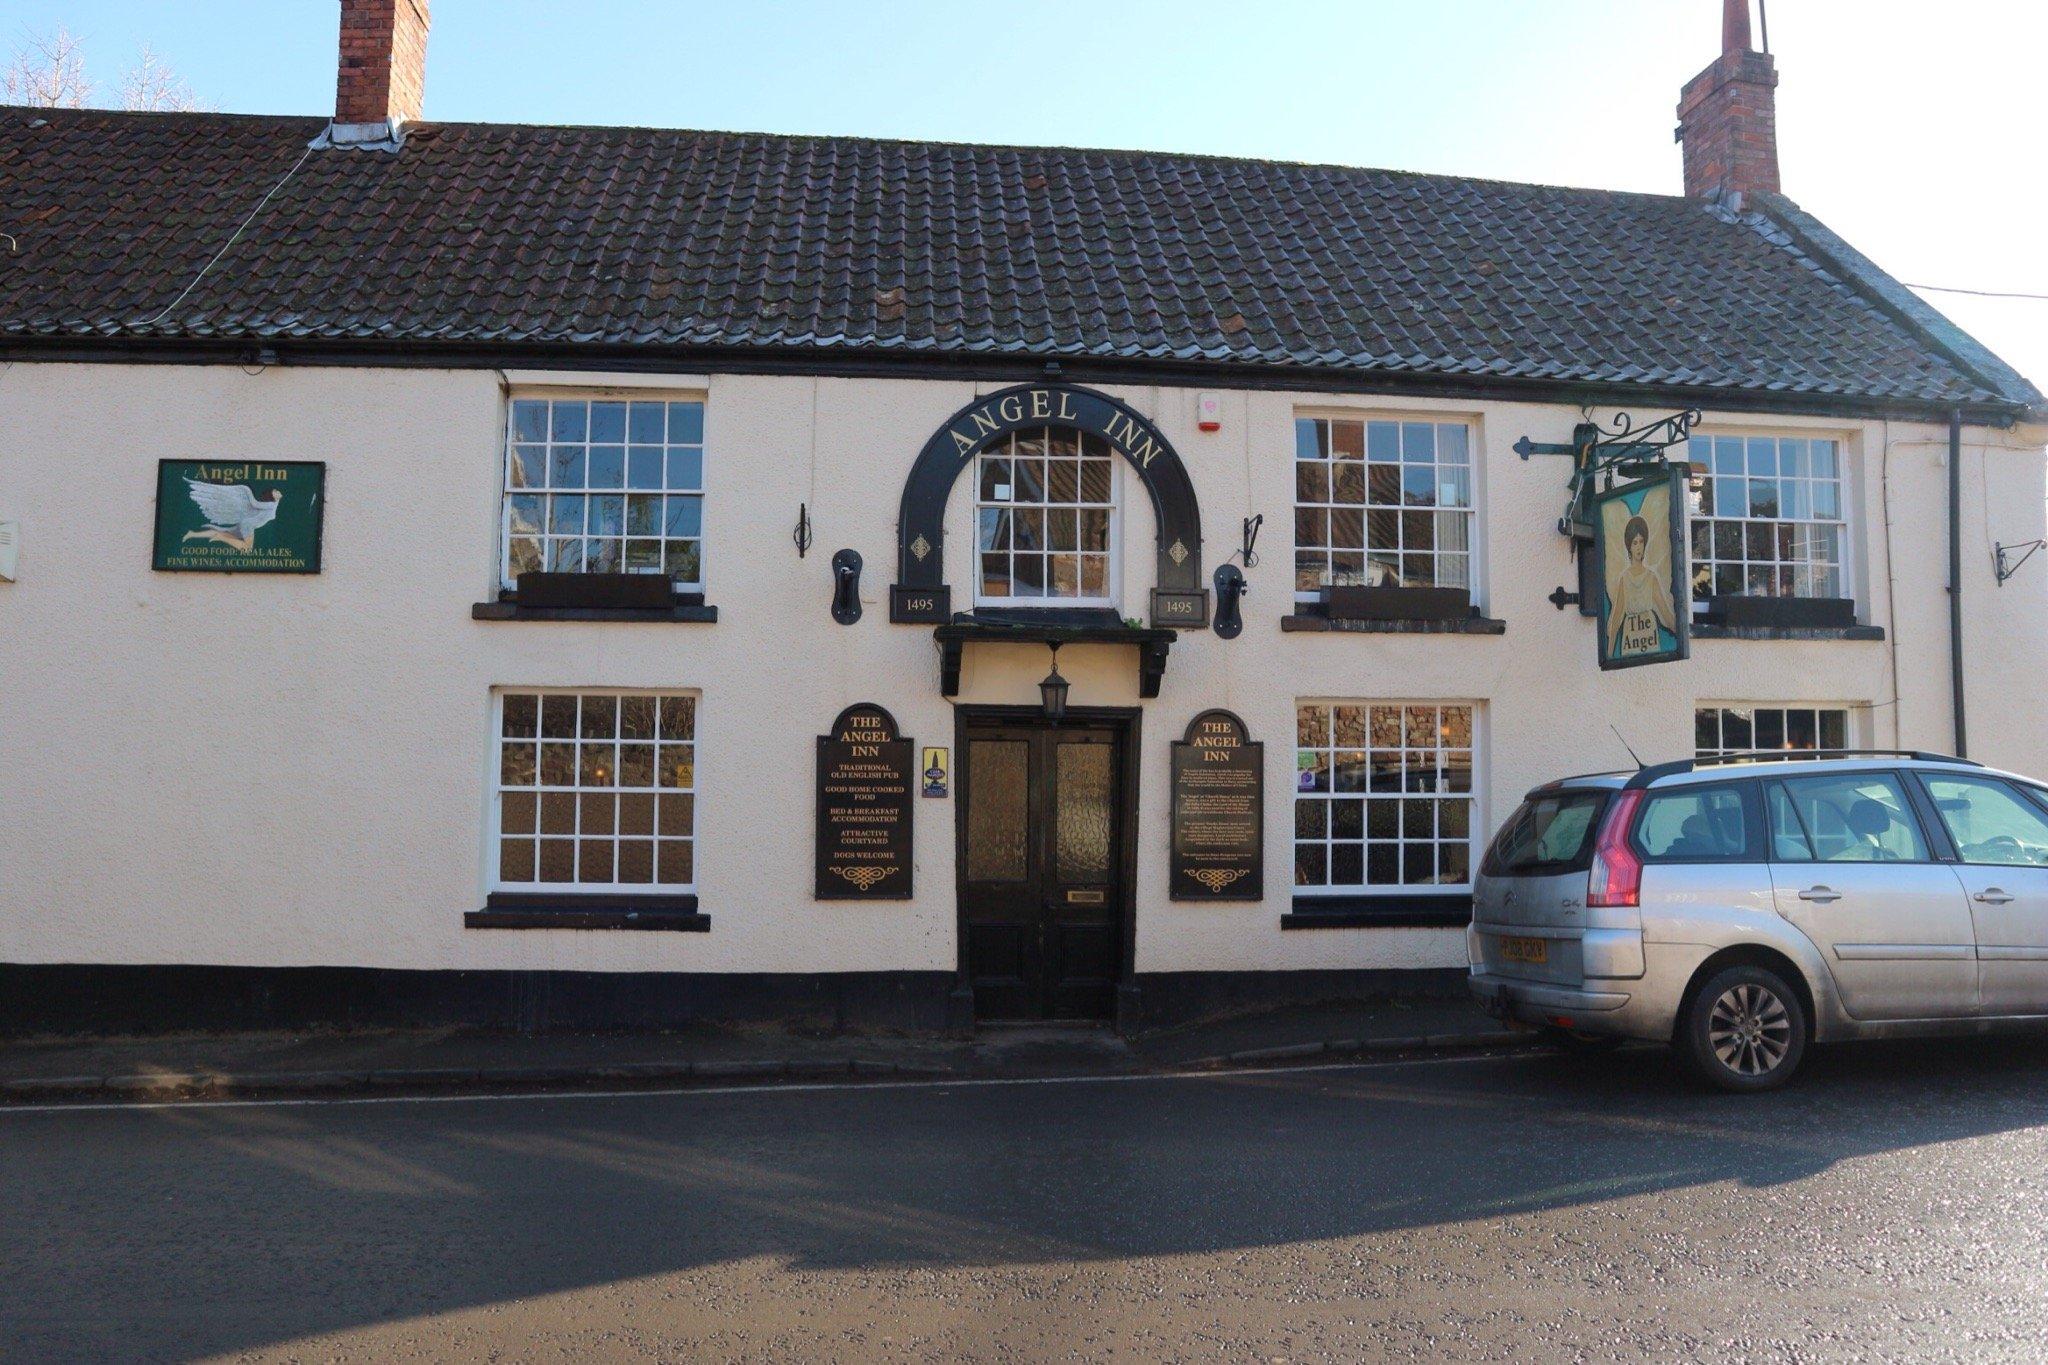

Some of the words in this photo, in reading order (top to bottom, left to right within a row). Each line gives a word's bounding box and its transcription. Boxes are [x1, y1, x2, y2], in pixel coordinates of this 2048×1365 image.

[950, 390, 1077, 458] ANGEL
[1102, 410, 1163, 469] INN
[194, 464, 249, 483] Angel
[255, 465, 288, 481] Inn
[181, 546, 208, 556] GOOD
[166, 557, 188, 566] FINE
[225, 558, 306, 568] ACCOMMODATION
[906, 599, 934, 611] 1495
[1166, 601, 1192, 613] 1495
[1628, 614, 1651, 631] The
[1623, 630, 1657, 652] Angel
[851, 717, 880, 727] THE
[1203, 722, 1231, 733] THE
[841, 731, 891, 742] ANGEL
[1194, 736, 1240, 747] ANGEL
[852, 746, 879, 757] INN
[1203, 750, 1230, 762] INN
[848, 771, 881, 779] ENGLISH
[831, 815, 898, 823] ACCOMMODATION
